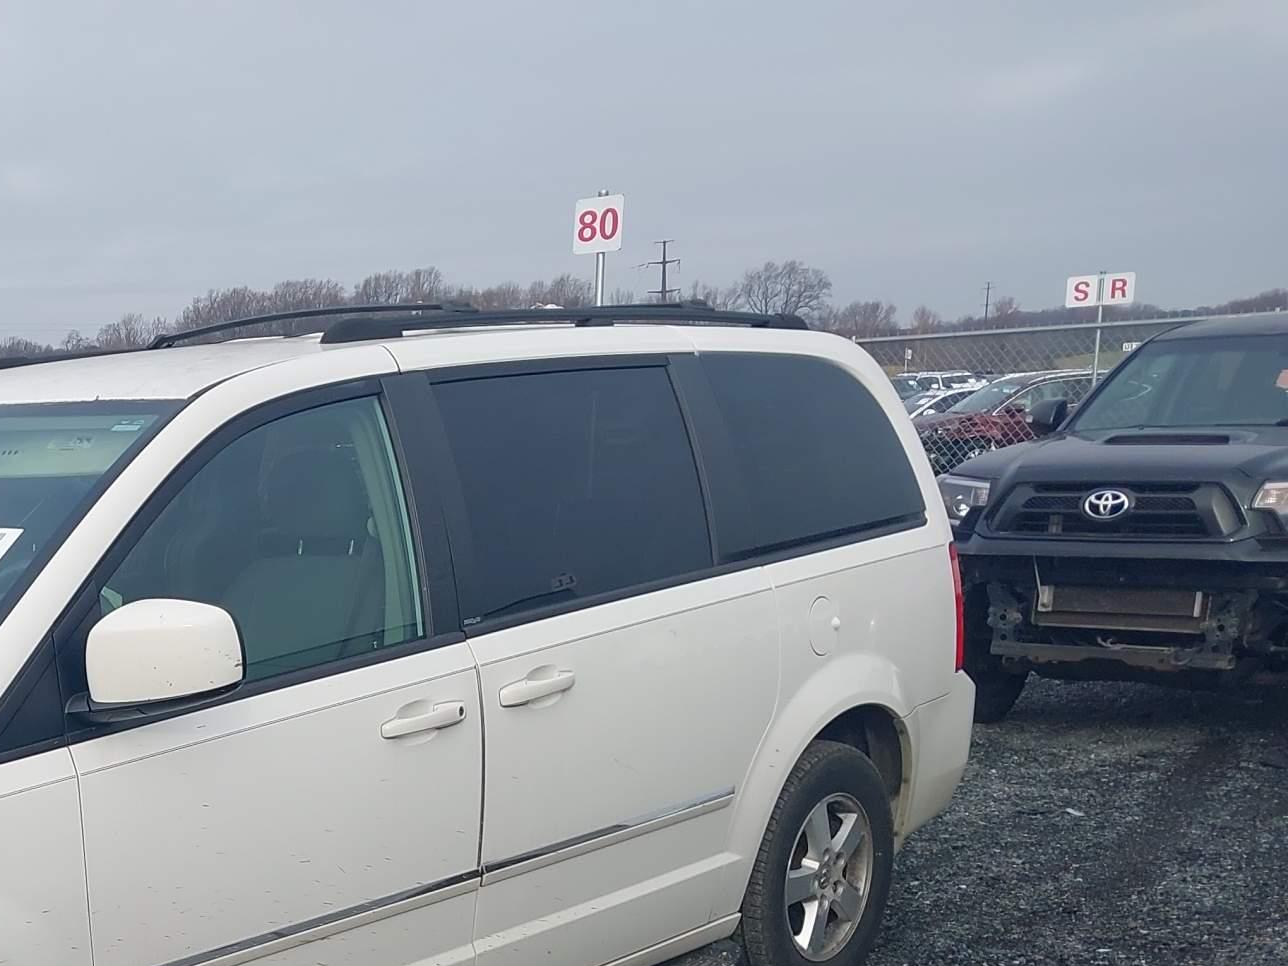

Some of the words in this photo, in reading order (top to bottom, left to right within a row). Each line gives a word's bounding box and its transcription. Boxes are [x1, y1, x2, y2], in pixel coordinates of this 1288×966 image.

[578, 207, 619, 242] 80
[1074, 281, 1090, 301] S
[1111, 278, 1128, 299] R
